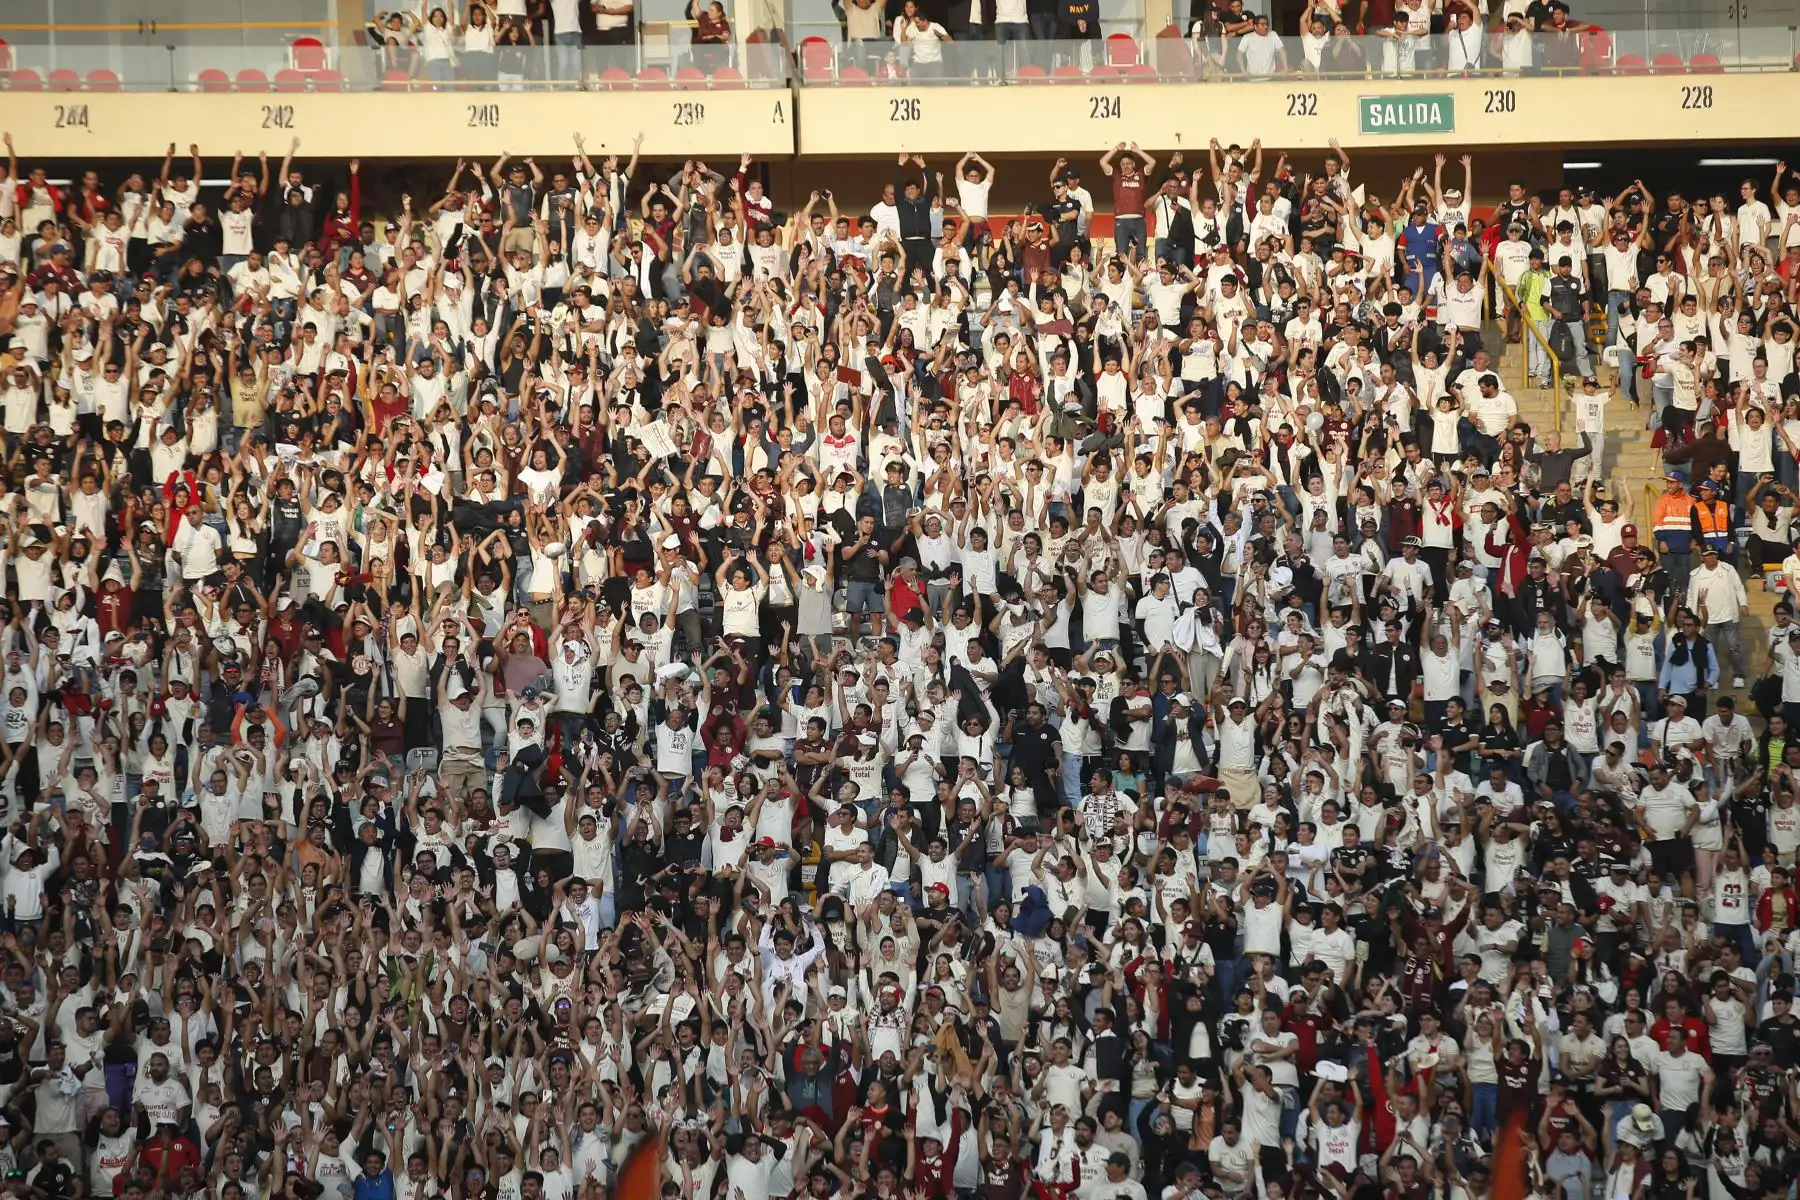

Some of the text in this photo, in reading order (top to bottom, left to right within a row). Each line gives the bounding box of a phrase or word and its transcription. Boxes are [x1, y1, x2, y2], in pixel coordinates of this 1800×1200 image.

[1069, 4, 1089, 14] NAVY
[1090, 95, 1121, 119] 234
[1286, 92, 1318, 116] 232
[1484, 90, 1516, 113] 230
[1681, 85, 1713, 109] 228
[55, 105, 89, 129] 244
[261, 105, 294, 129] 242
[467, 104, 500, 128] 240
[773, 100, 785, 124] A
[889, 98, 921, 122] 236
[1369, 102, 1442, 126] SALIDA
